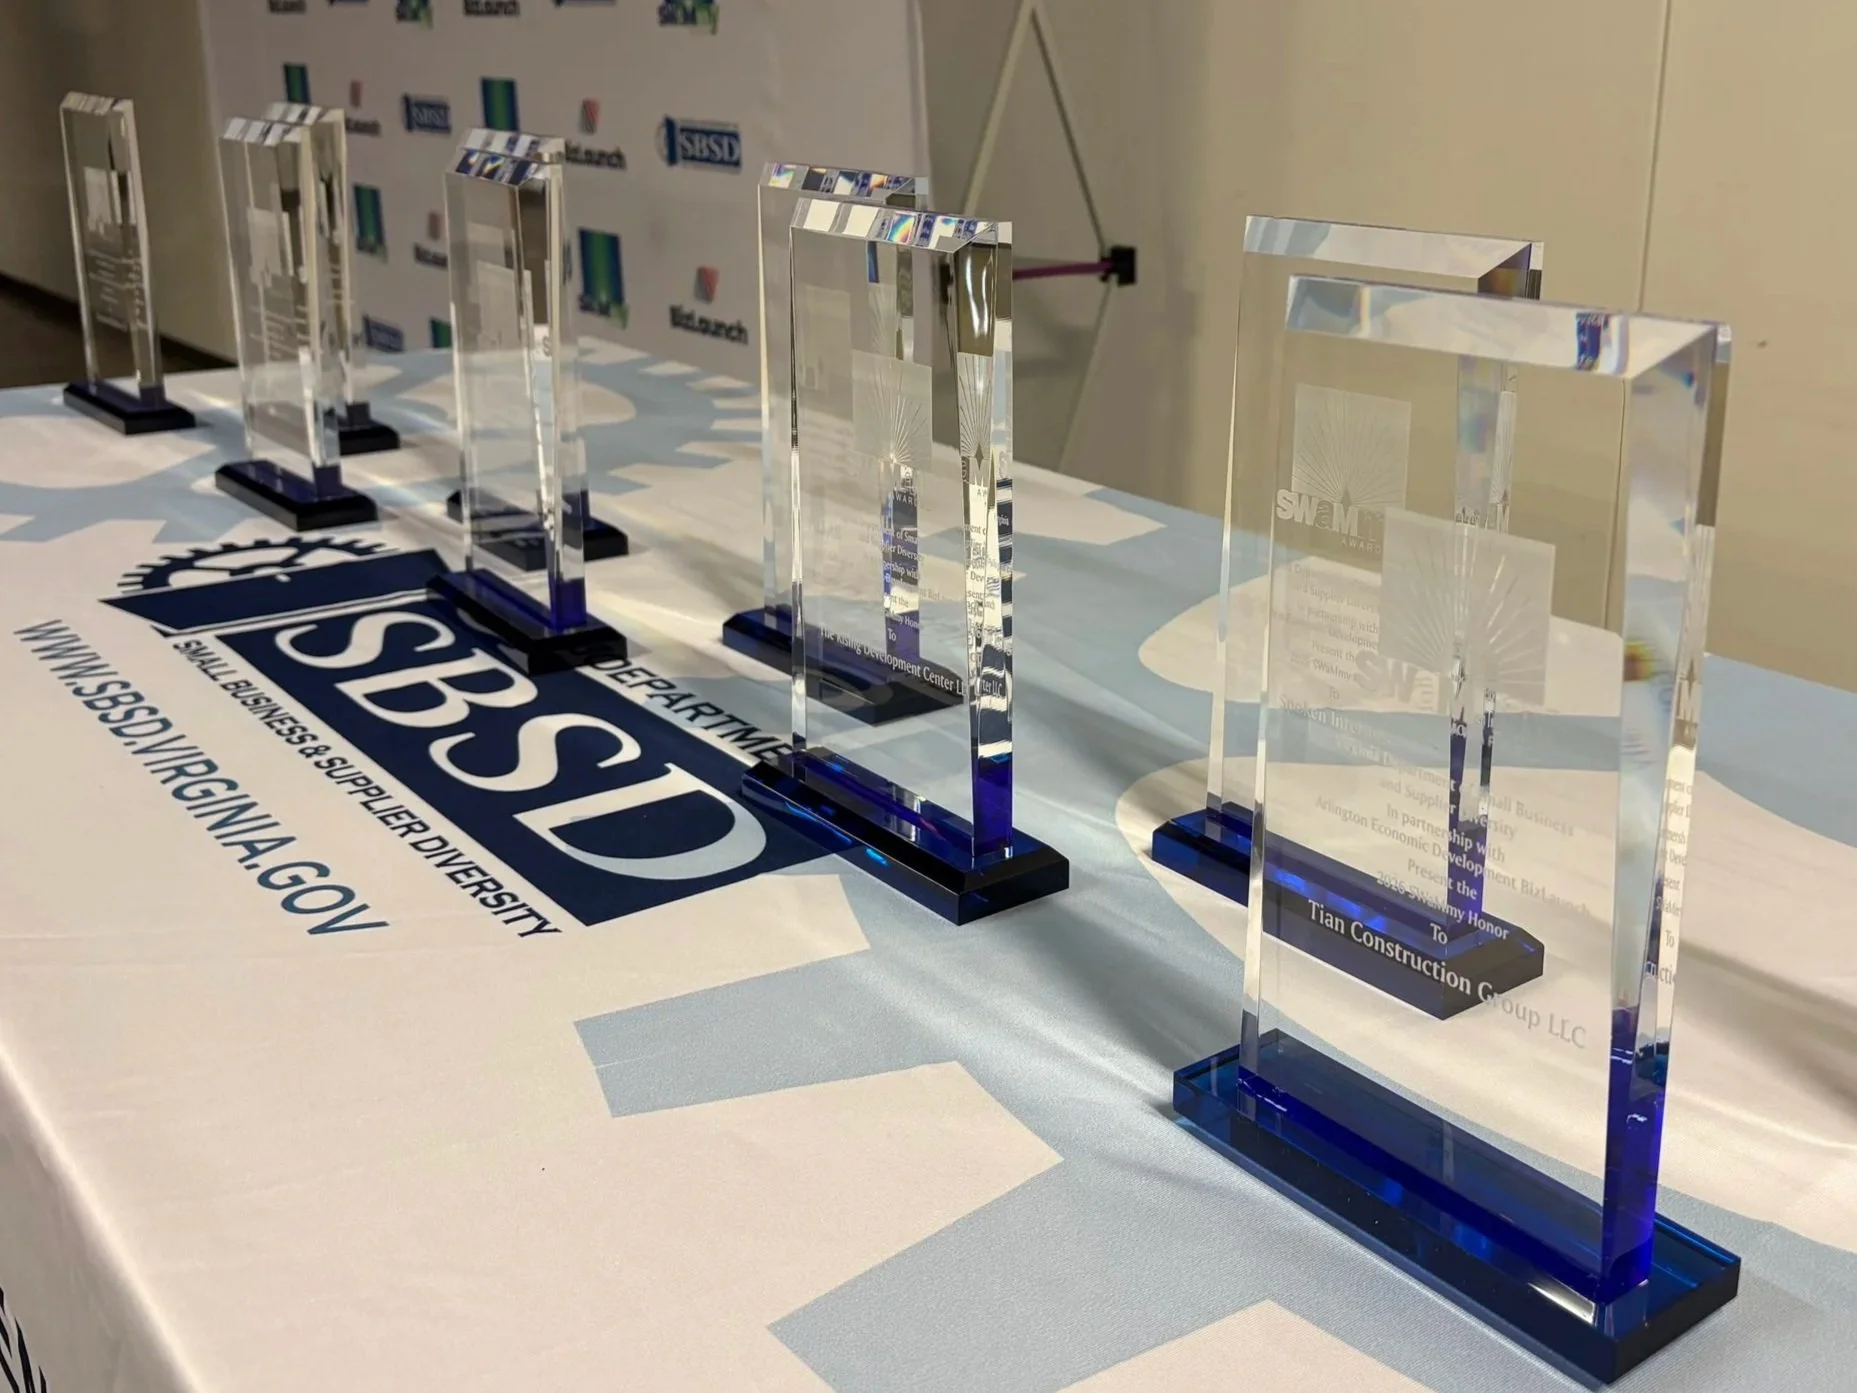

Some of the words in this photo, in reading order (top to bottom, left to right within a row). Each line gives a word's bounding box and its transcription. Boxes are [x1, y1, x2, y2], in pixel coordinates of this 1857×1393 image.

[680, 131, 740, 167] SBSD
[863, 644, 922, 679] Development
[922, 665, 955, 692] Center
[590, 657, 794, 764] DEPARTME
[274, 611, 767, 880] SBSD
[13, 619, 390, 936] WWW.SBSD.VIRGINIA.GOV
[172, 638, 238, 683] SMALL
[220, 678, 319, 748] BUSINESS
[298, 743, 330, 759] &
[314, 756, 432, 838] SUPPLIER
[409, 834, 563, 939] DIVERSITY
[1315, 794, 1369, 829] Arlington
[1371, 816, 1430, 853] Economic
[1432, 842, 1517, 890] Development
[1386, 802, 1400, 818] In
[1401, 812, 1474, 852] partnership
[1476, 839, 1506, 864] with
[1515, 800, 1575, 837] Business
[1408, 858, 1454, 891] Present
[1456, 880, 1478, 901] the
[1429, 922, 1449, 946] To
[1467, 909, 1511, 941] Honor
[1308, 898, 1346, 935] Tian
[1350, 921, 1472, 996] Construction
[1477, 981, 1541, 1032] Group
[1548, 1012, 1588, 1049] LLC
